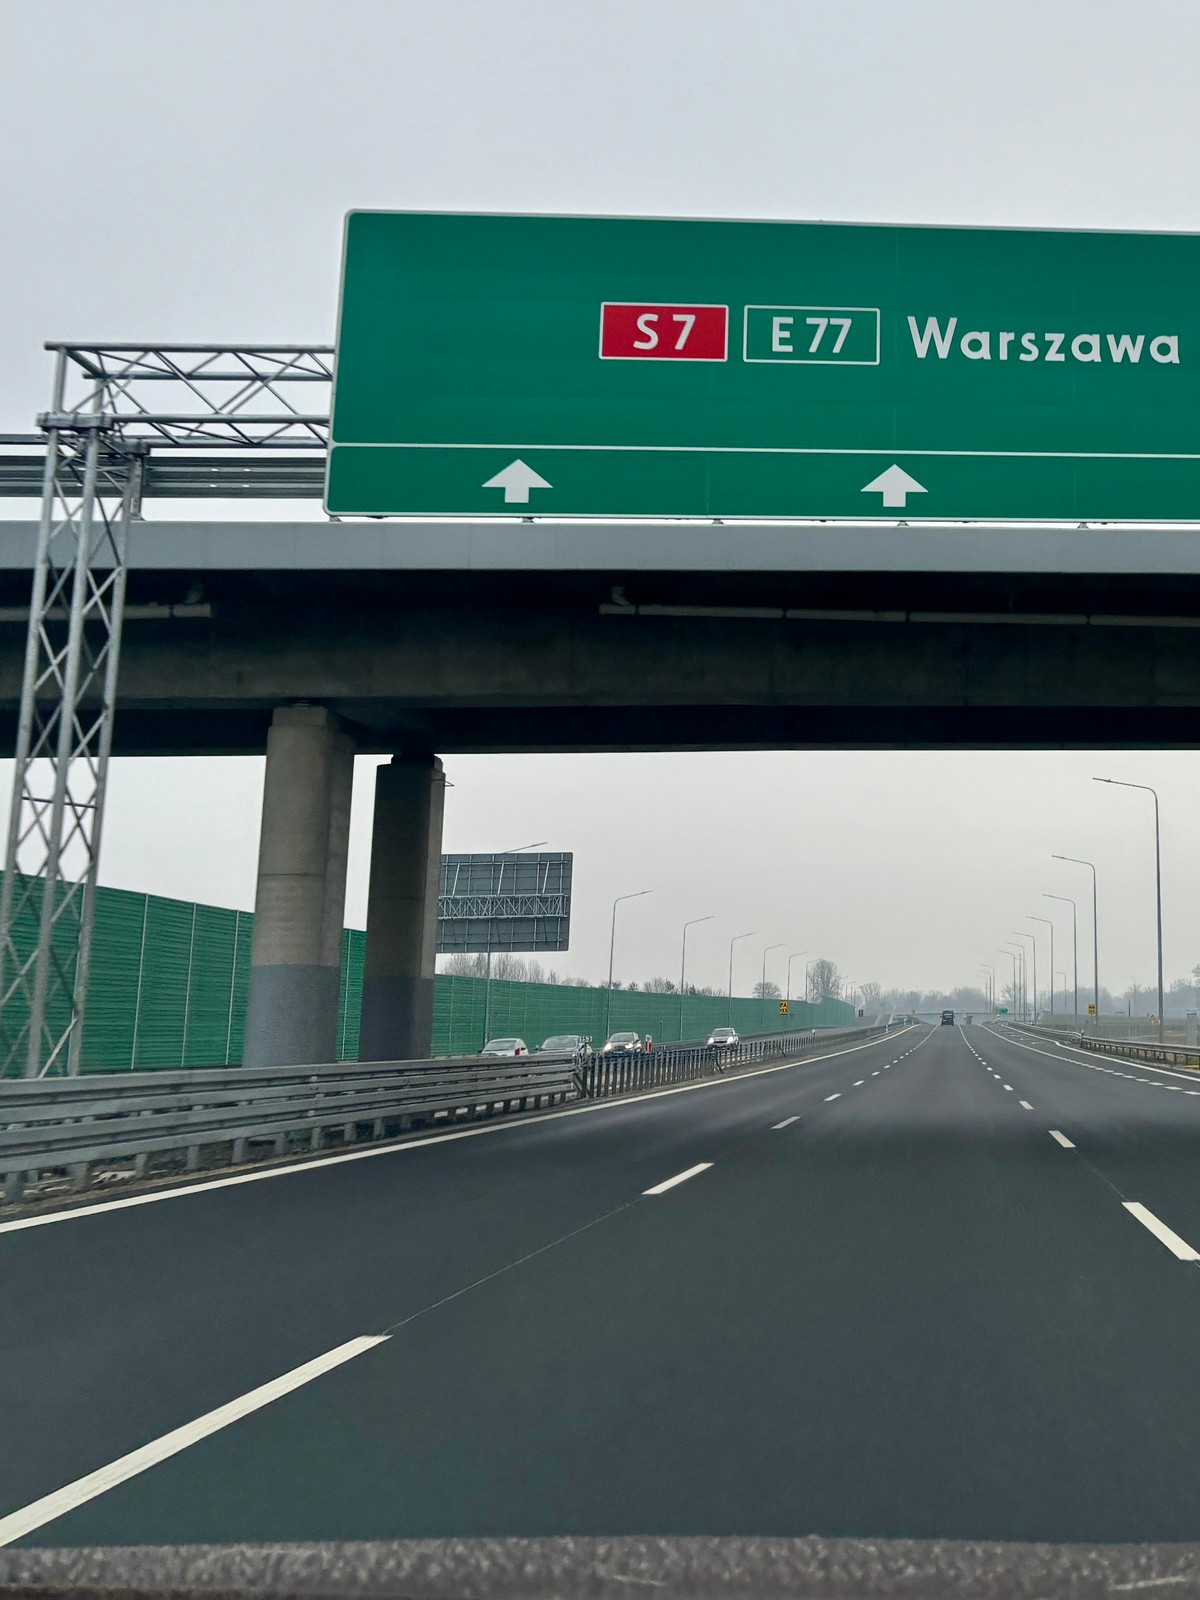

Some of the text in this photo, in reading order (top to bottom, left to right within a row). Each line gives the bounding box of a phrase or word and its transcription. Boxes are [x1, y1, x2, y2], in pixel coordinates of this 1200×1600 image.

[633, 313, 696, 350] S 7
[771, 316, 852, 354] E 77
[907, 315, 1180, 364] Warszawa
